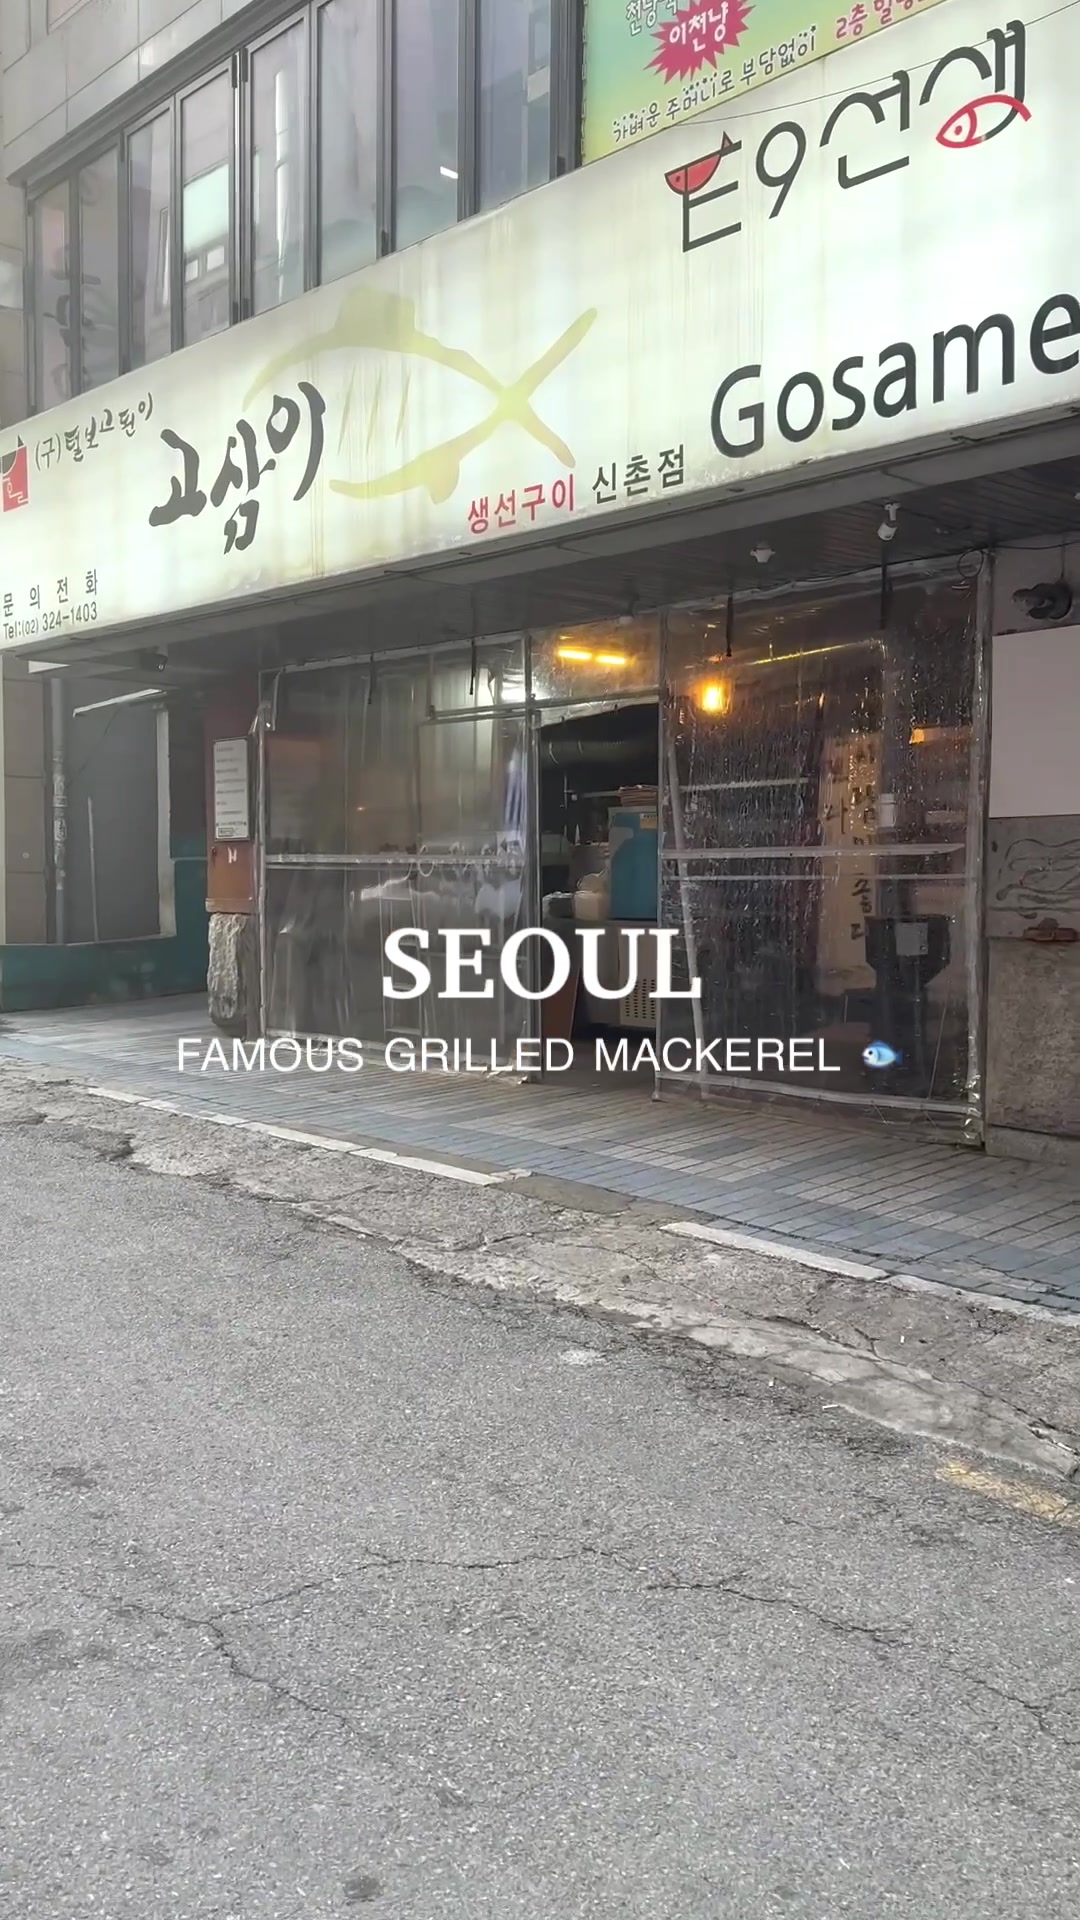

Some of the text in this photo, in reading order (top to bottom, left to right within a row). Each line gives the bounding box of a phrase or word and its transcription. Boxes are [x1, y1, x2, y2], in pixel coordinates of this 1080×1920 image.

[669, 1, 729, 52] 이천냥
[613, 102, 661, 143] 가벼운
[666, 70, 736, 121] 주머니로
[741, 25, 818, 86] 부담없이
[835, 3, 868, 39] 2층
[148, 381, 326, 555] 고삼이
[466, 443, 686, 535] 생선구이 신촌점
[42, 601, 98, 631] 324-1403
